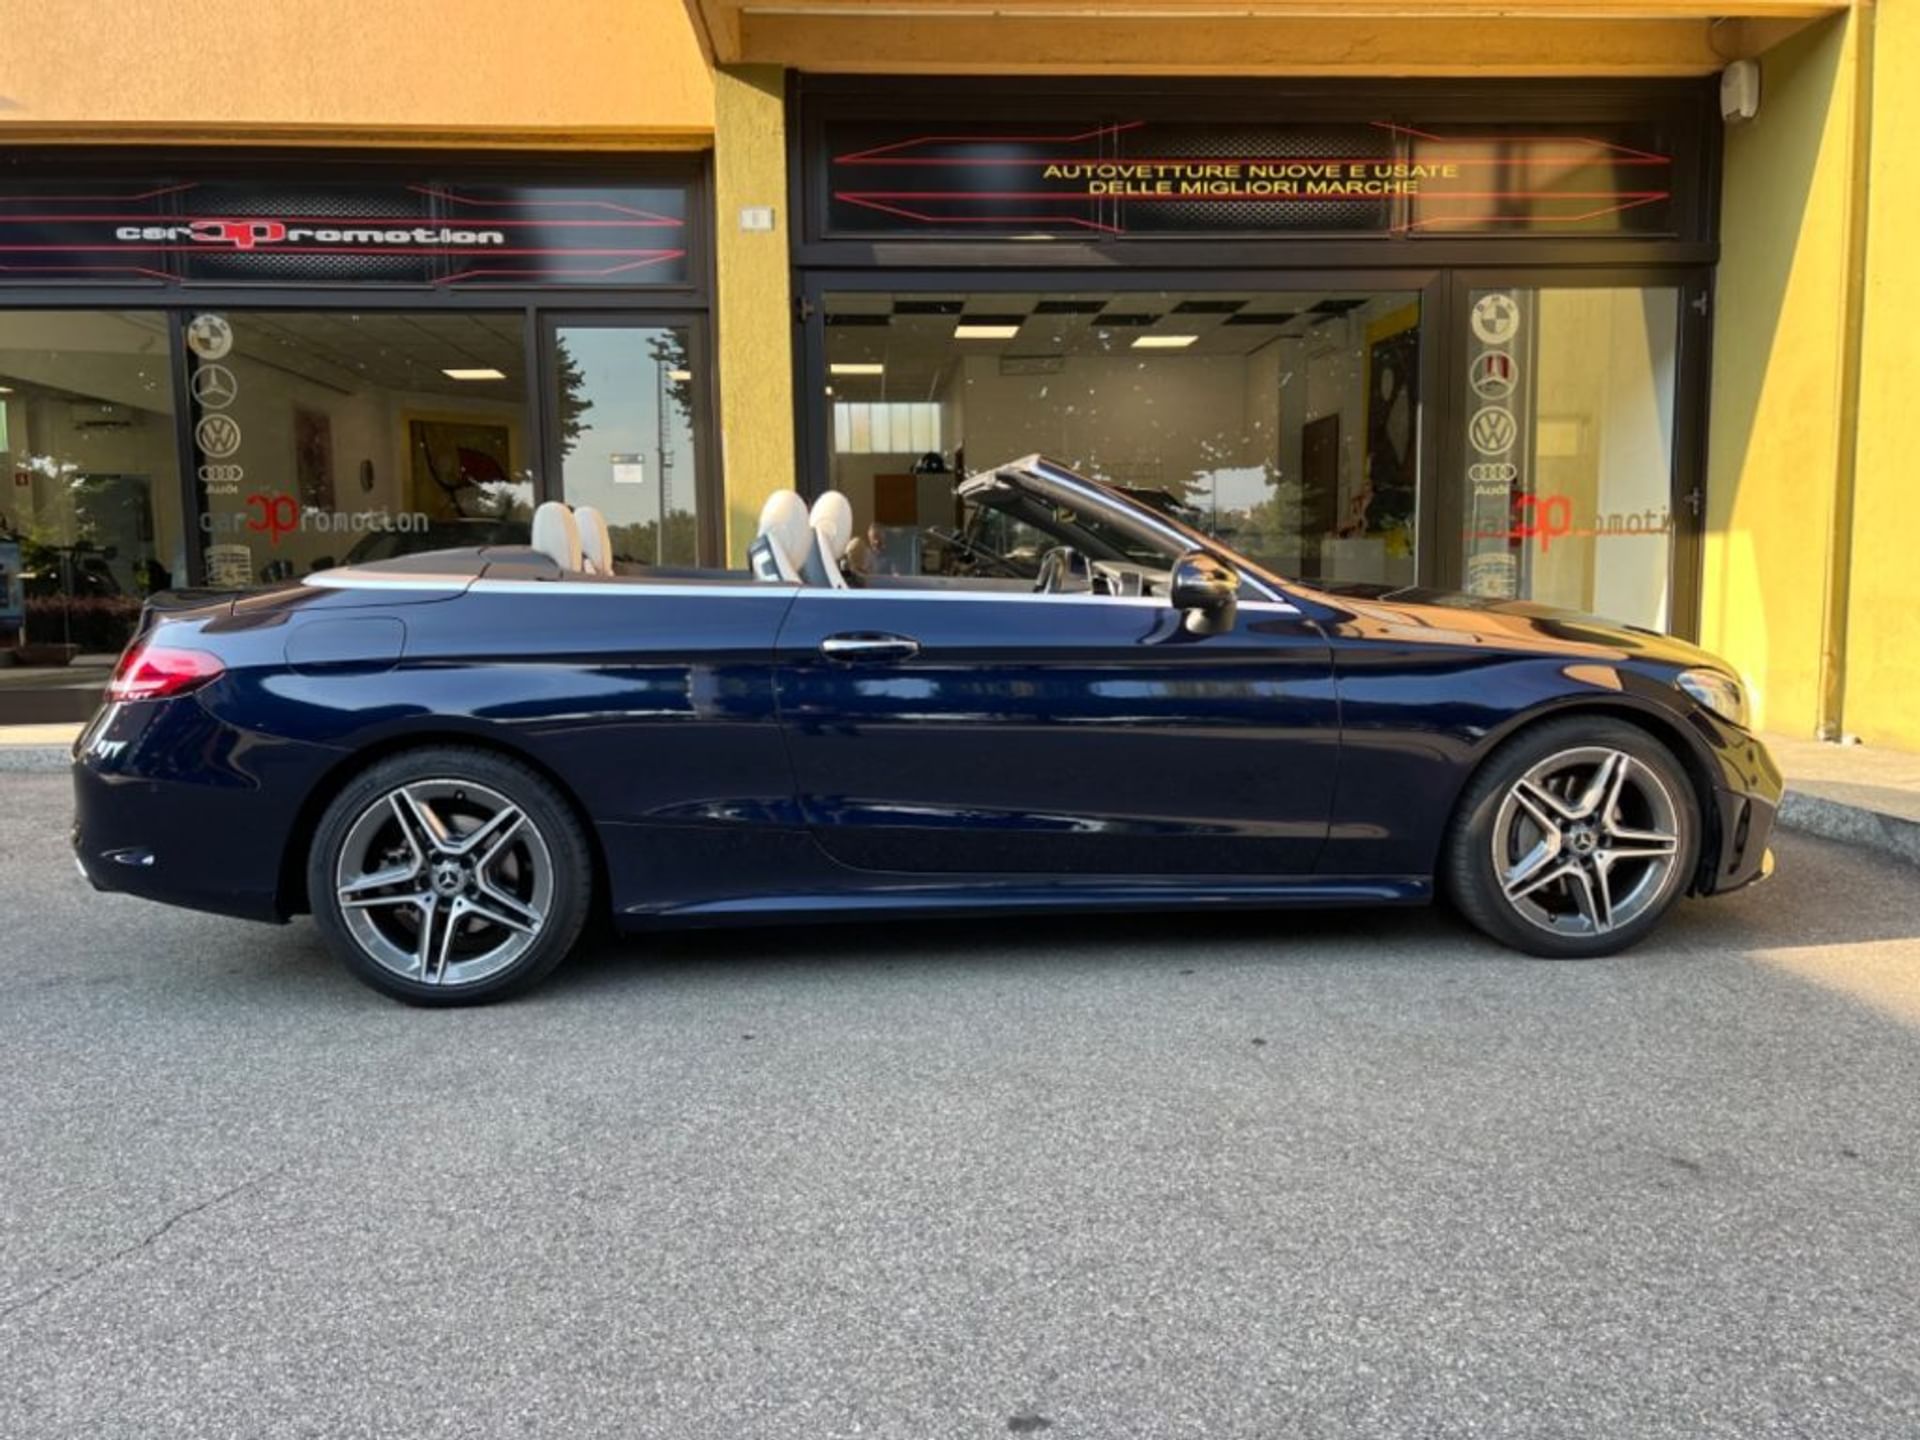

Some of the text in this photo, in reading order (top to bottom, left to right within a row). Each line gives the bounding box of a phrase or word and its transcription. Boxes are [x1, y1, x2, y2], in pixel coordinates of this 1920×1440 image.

[1043, 164, 1460, 179] AUTOVETTURE NUOVE E USATE
[1088, 180, 1419, 195] DELLE MIGLIORI MARCHE
